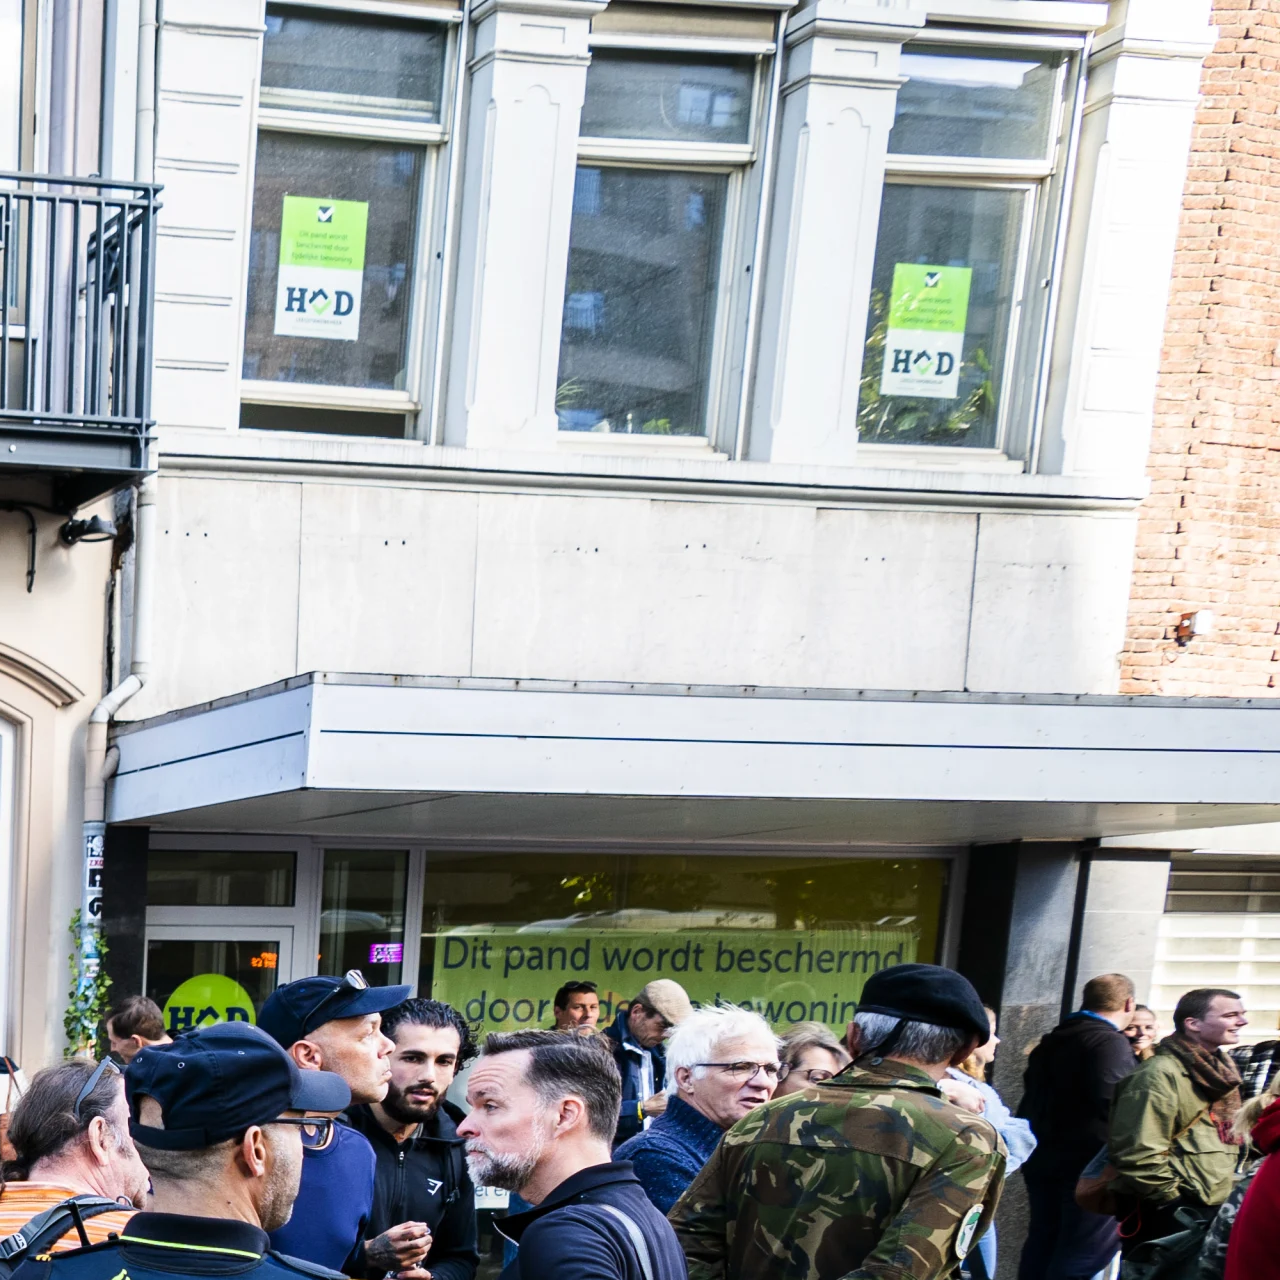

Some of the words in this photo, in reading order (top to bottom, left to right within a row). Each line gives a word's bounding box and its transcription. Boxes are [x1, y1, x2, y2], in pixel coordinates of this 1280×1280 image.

[443, 936, 492, 970] Dit
[503, 939, 591, 978] pand
[602, 939, 703, 974] wordt
[716, 940, 904, 975] beschermd
[466, 989, 545, 1023] door
